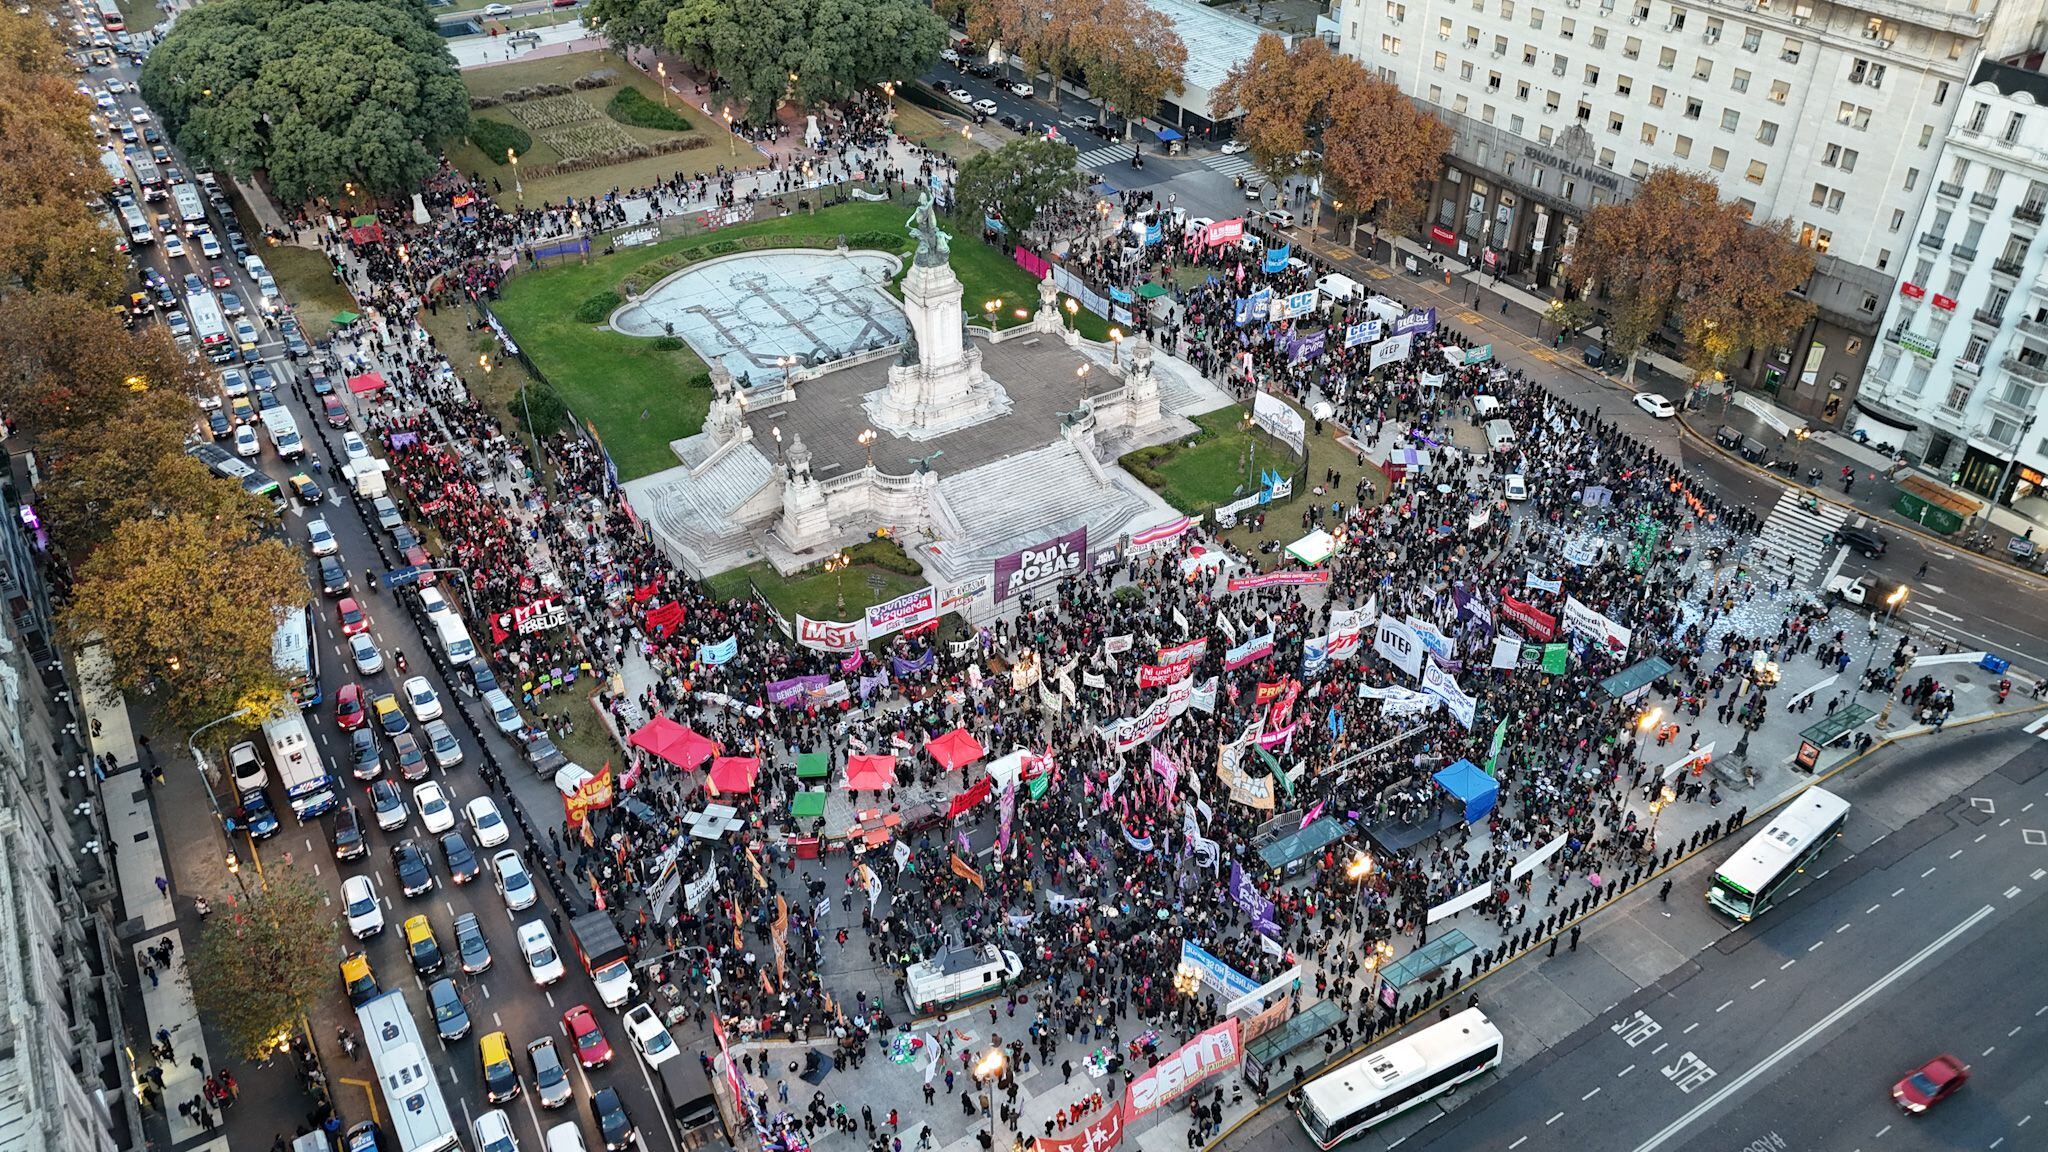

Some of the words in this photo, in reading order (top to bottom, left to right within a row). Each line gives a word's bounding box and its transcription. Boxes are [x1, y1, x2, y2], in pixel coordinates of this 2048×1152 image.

[1525, 146, 1557, 167] SENADO
[1559, 159, 1570, 173] DE
[1571, 163, 1582, 178] LA
[1350, 321, 1377, 336] CCC
[1379, 343, 1400, 358] UTEP
[1008, 551, 1082, 590] ROSAS
[514, 599, 564, 622] MTL
[518, 612, 567, 637] REBELDE
[805, 622, 858, 649] MST
[1381, 628, 1412, 656] UTEP
[1610, 1009, 1663, 1048] BUS
[1660, 1051, 1718, 1094] BUS
